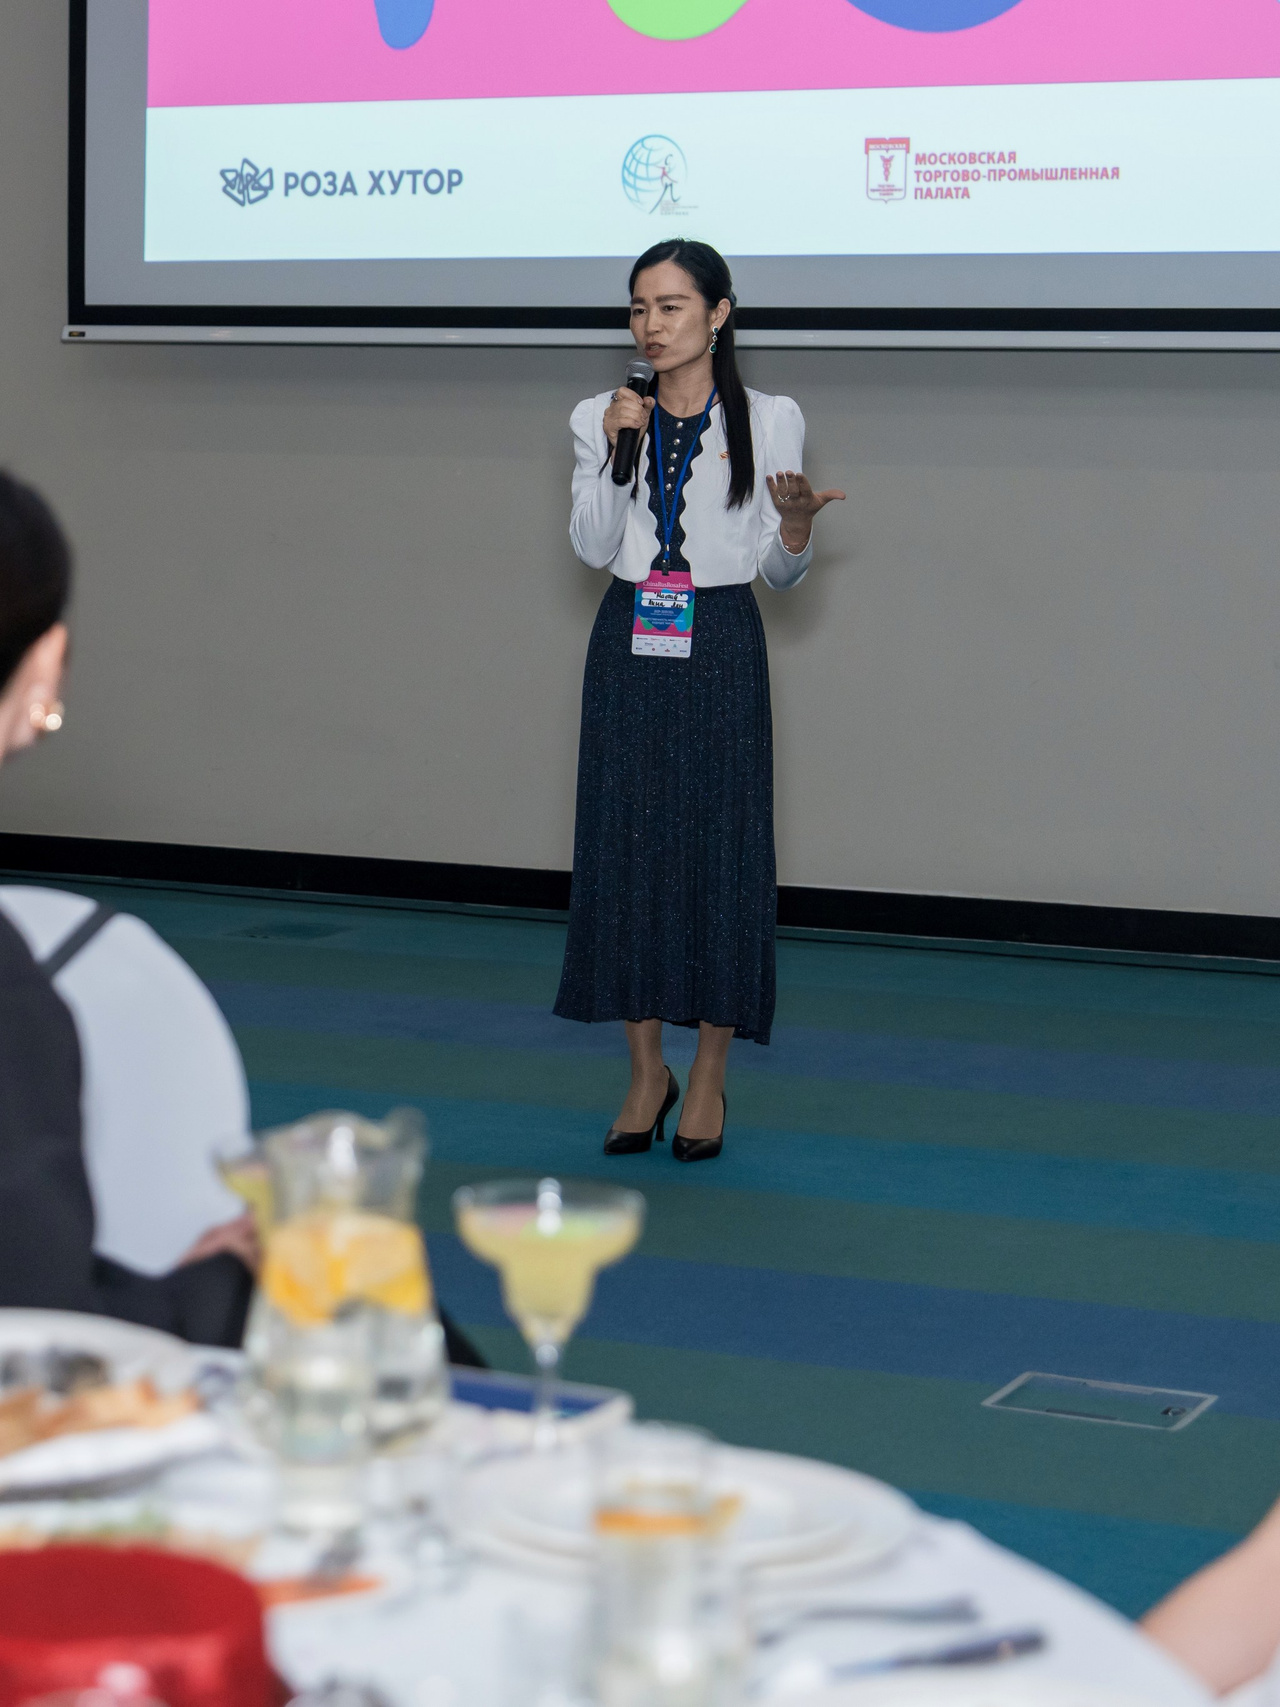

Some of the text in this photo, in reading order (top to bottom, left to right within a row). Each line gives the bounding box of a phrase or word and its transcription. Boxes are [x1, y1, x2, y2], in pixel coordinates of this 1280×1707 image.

[914, 151, 1017, 166] МОСКОВСКАЯ
[283, 168, 464, 197] РОЗА ХУТОР
[914, 167, 1120, 183] ТОРГОВО-ПРОМЫШЛЕННАЯ
[913, 187, 971, 200] ПАЛАТА
